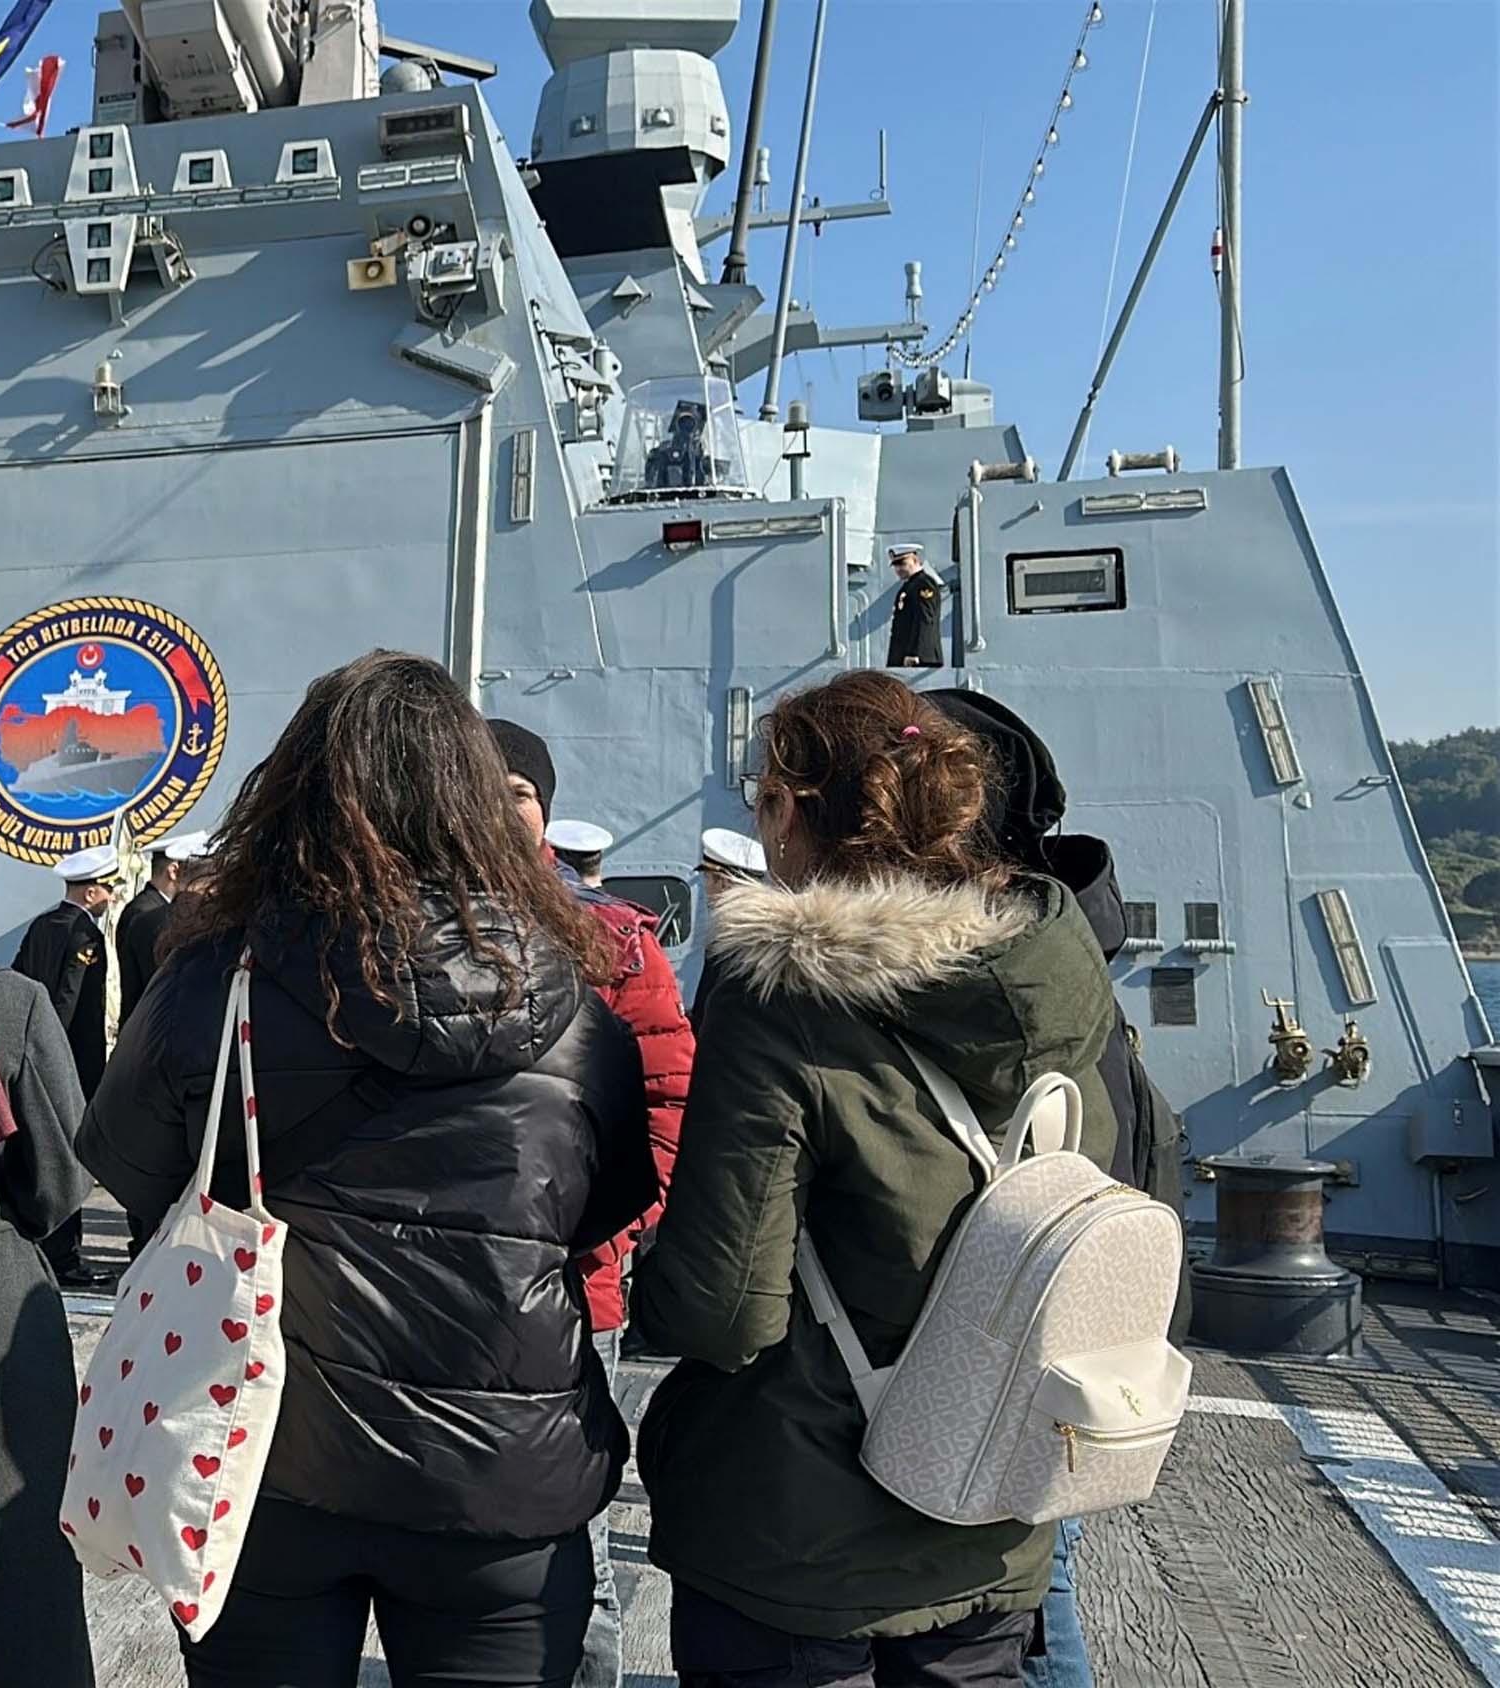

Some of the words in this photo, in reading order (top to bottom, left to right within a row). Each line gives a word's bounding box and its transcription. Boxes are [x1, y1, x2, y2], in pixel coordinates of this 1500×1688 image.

[6, 635, 39, 662] TCG
[40, 614, 136, 643] HEYBELİADA
[135, 625, 150, 641] F
[146, 631, 176, 657] 511
[22, 825, 75, 850] VATAN
[78, 776, 187, 849] TOPĞINDAN
